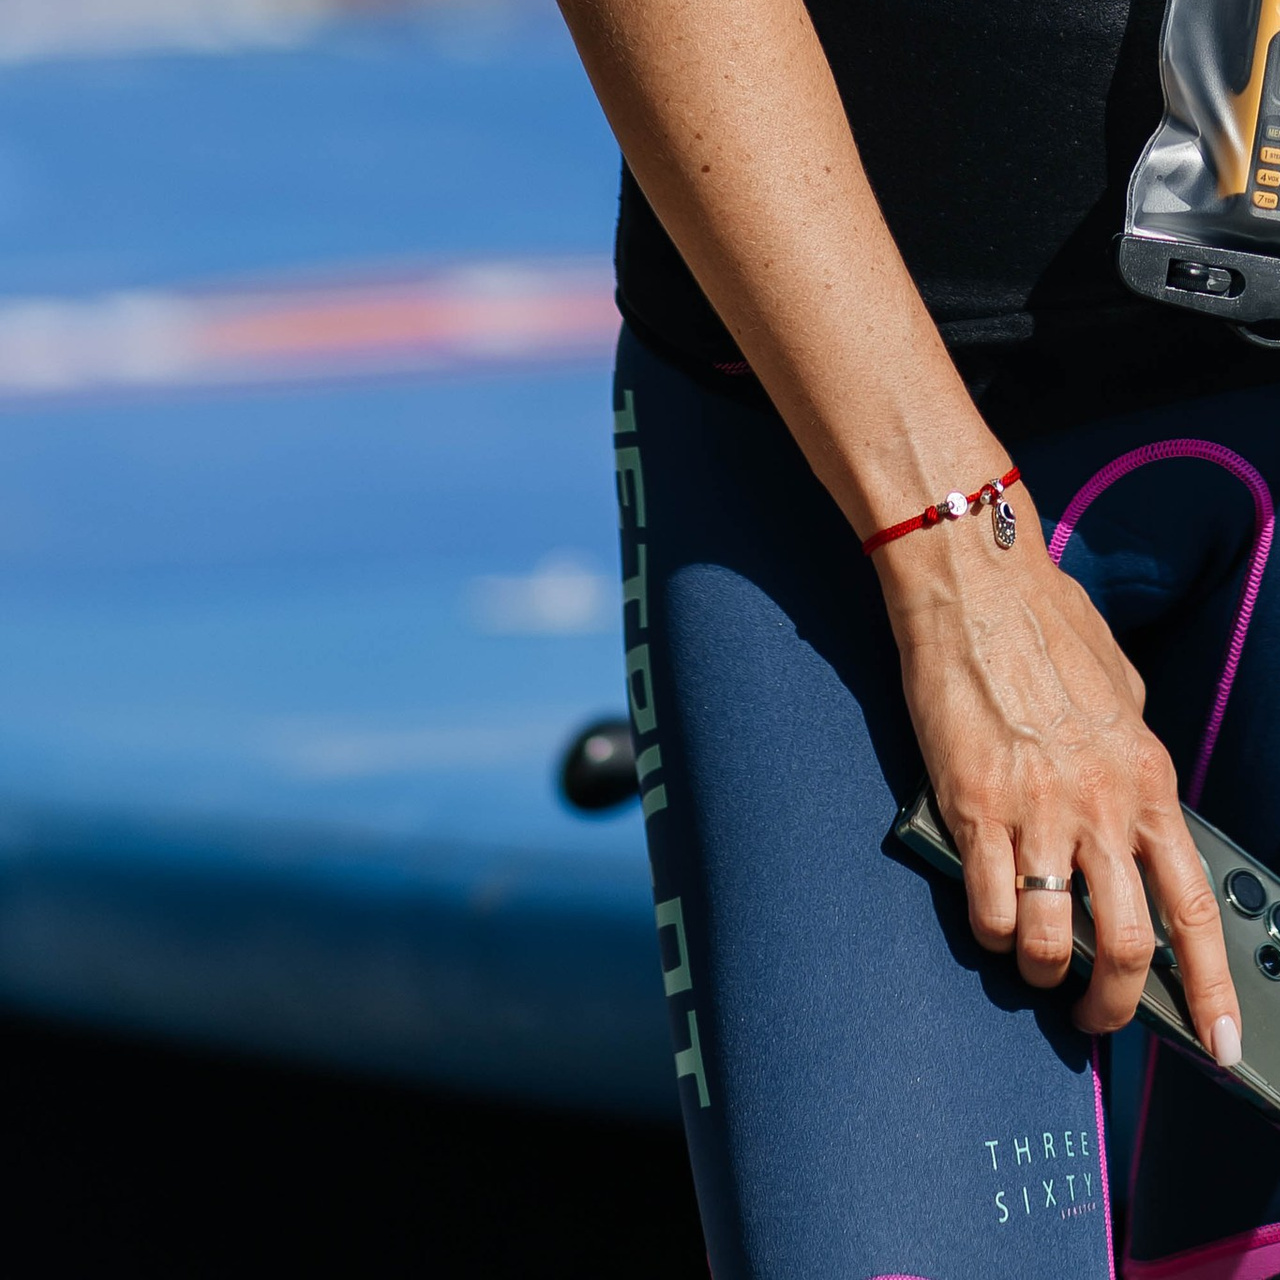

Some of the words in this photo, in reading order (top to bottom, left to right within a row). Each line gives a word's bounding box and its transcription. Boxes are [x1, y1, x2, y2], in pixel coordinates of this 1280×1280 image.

[1260, 173, 1266, 182] 4
[1258, 195, 1265, 204] 7
[985, 1131, 1090, 1171] THREE
[995, 1173, 1092, 1223] SIXTY
